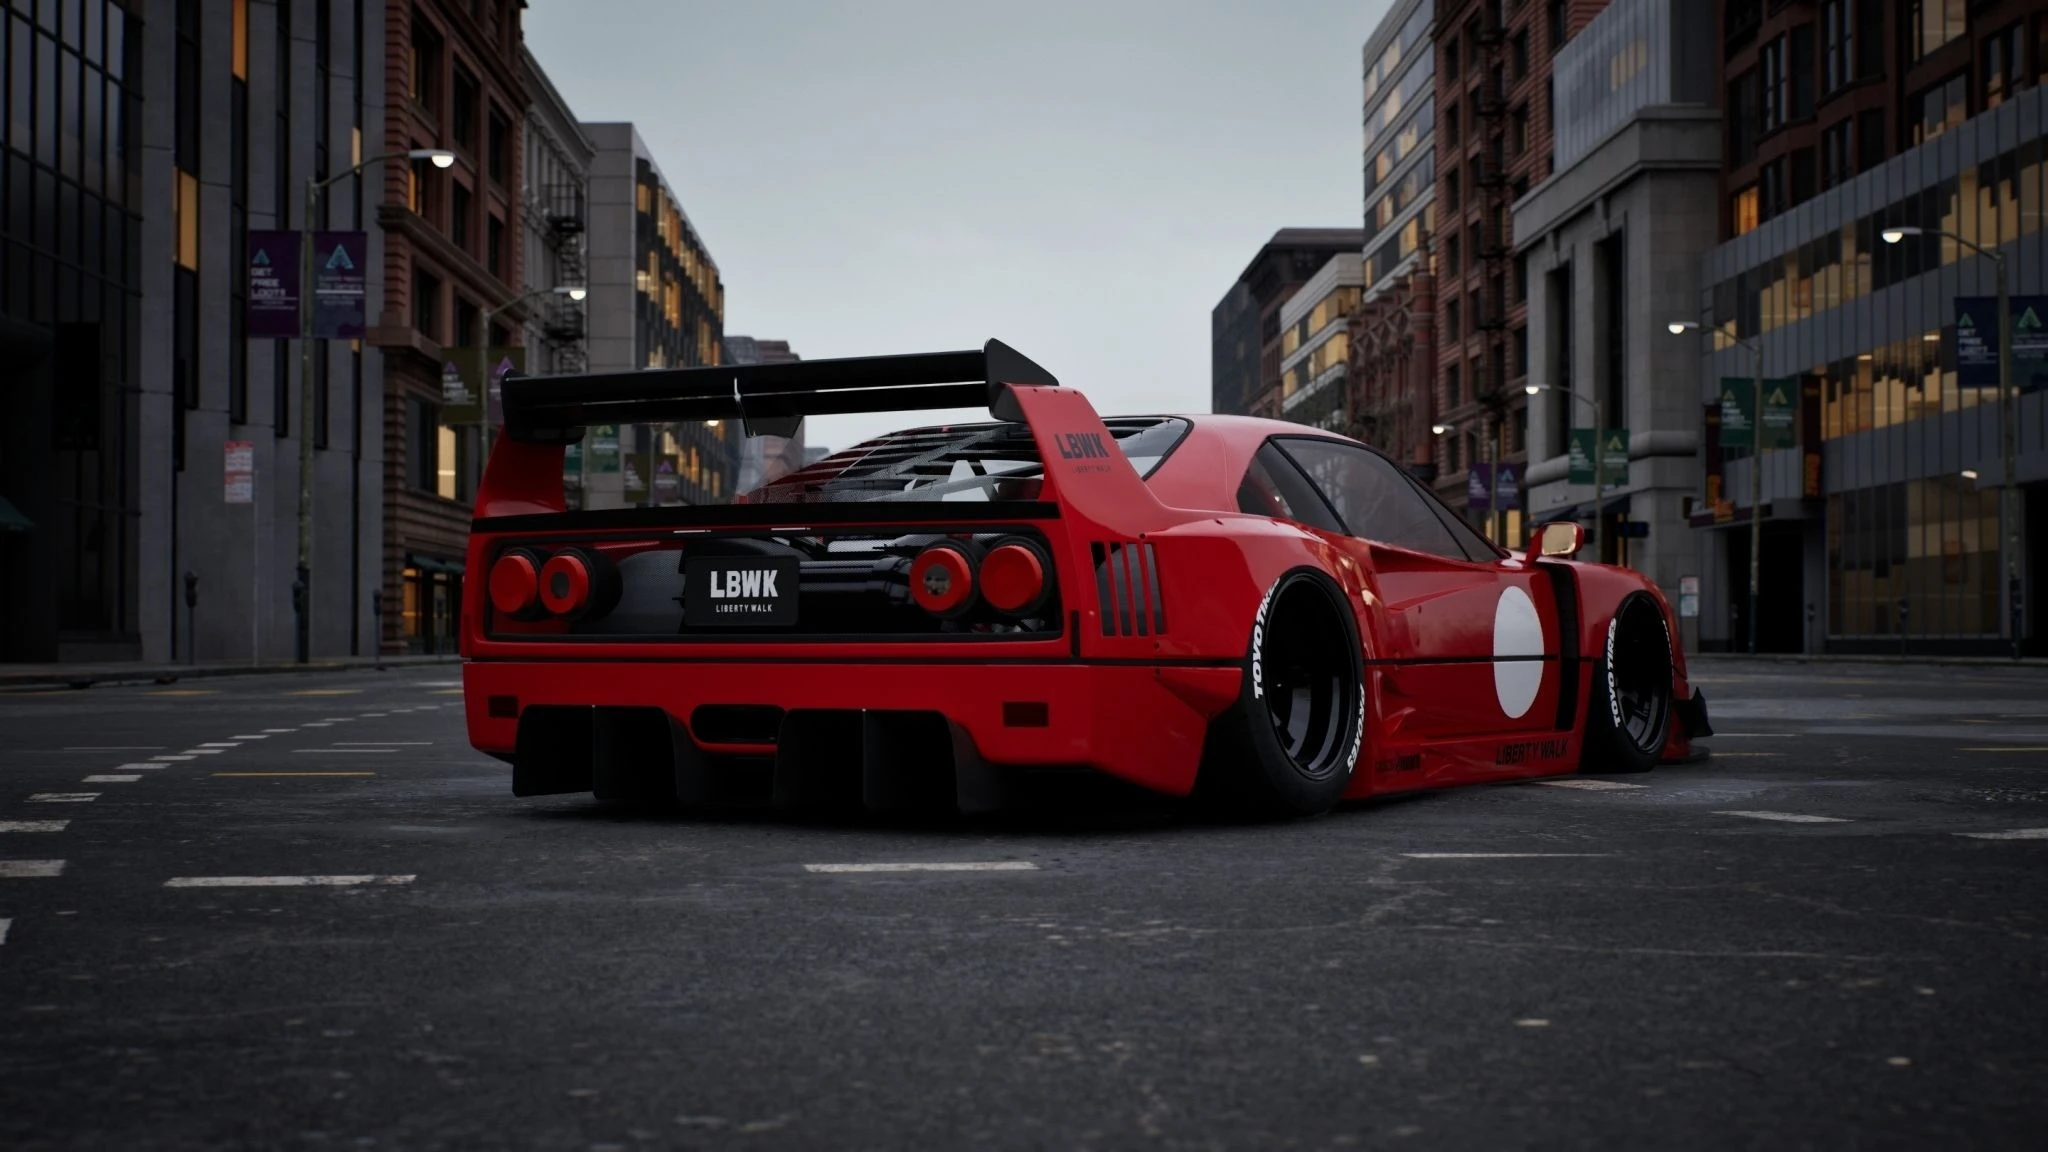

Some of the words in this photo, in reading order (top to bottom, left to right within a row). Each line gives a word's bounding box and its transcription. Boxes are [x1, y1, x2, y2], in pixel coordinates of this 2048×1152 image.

[1054, 432, 1111, 460] LBWK
[709, 569, 780, 599] LBWK
[715, 604, 749, 613] LIBERTY
[750, 603, 773, 613] WALK
[1252, 624, 1264, 700] TOYO
[1607, 671, 1622, 729] TOYO
[1495, 741, 1540, 766] LIBERTY
[1540, 738, 1569, 761] WALK
